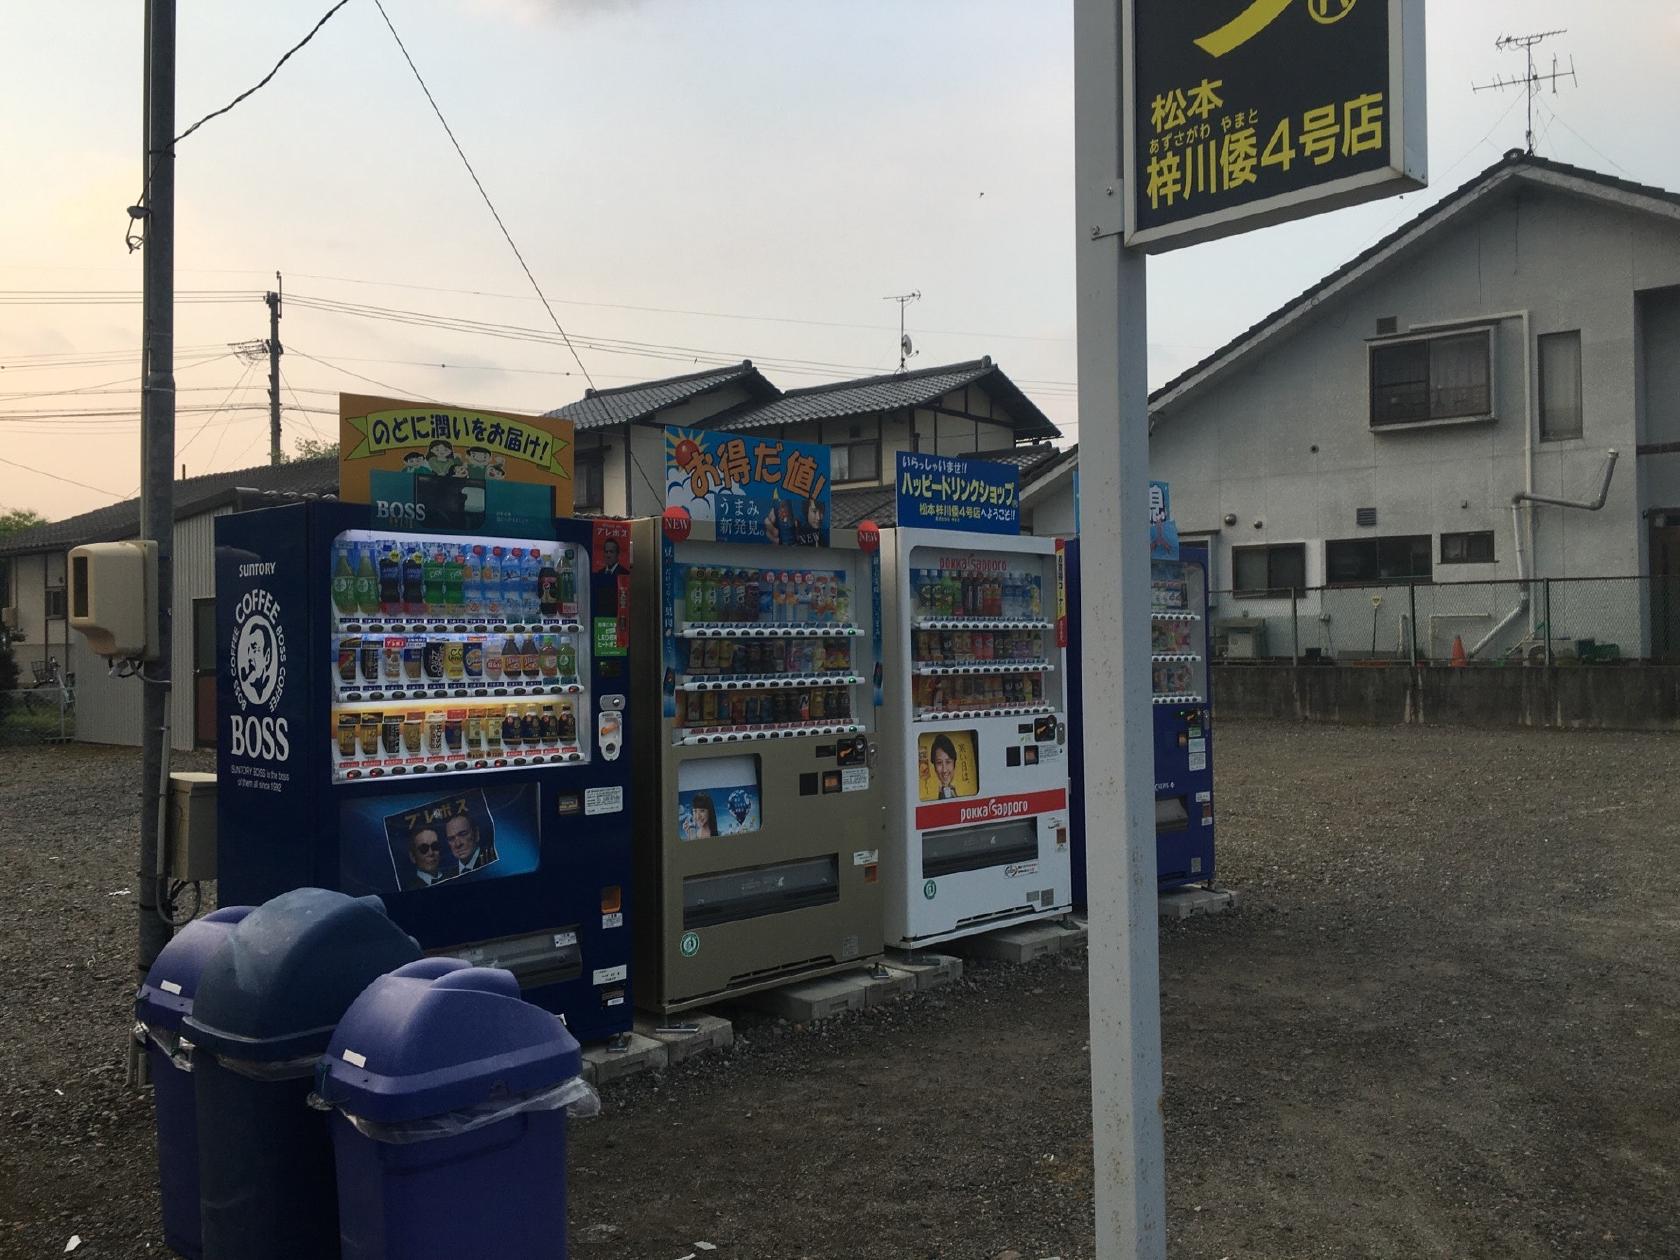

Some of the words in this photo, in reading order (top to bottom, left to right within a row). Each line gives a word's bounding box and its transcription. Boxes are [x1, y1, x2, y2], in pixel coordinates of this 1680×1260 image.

[1151, 78, 1224, 133] 松本
[1149, 122, 1210, 154] あずさがわ
[1220, 107, 1259, 129] やまと
[720, 497, 760, 516] うまみ
[901, 472, 1015, 507] ハッピードリンクショップ
[376, 500, 426, 521] BOSS
[665, 517, 689, 530] NEW
[720, 517, 765, 537] 新発見。
[860, 531, 878, 543] NEW
[235, 588, 281, 625] COFFEE
[276, 624, 287, 663] BOSS
[230, 715, 290, 762] BOSS
